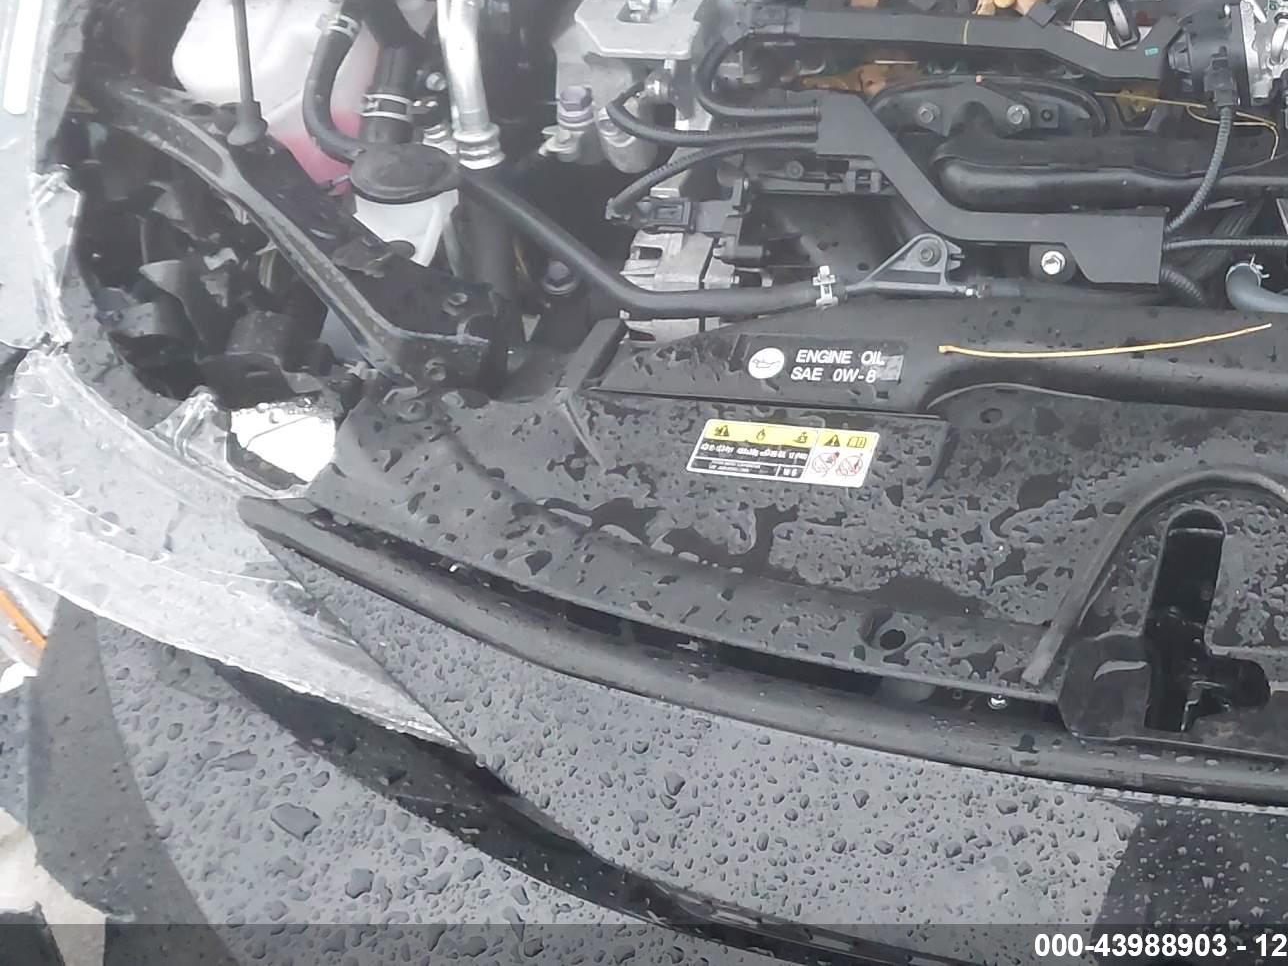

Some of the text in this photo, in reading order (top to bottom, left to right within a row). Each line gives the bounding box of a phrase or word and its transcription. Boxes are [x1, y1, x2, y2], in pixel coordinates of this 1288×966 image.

[795, 349, 886, 366] ENGINE OIL
[790, 366, 878, 384] SAE 0W-8
